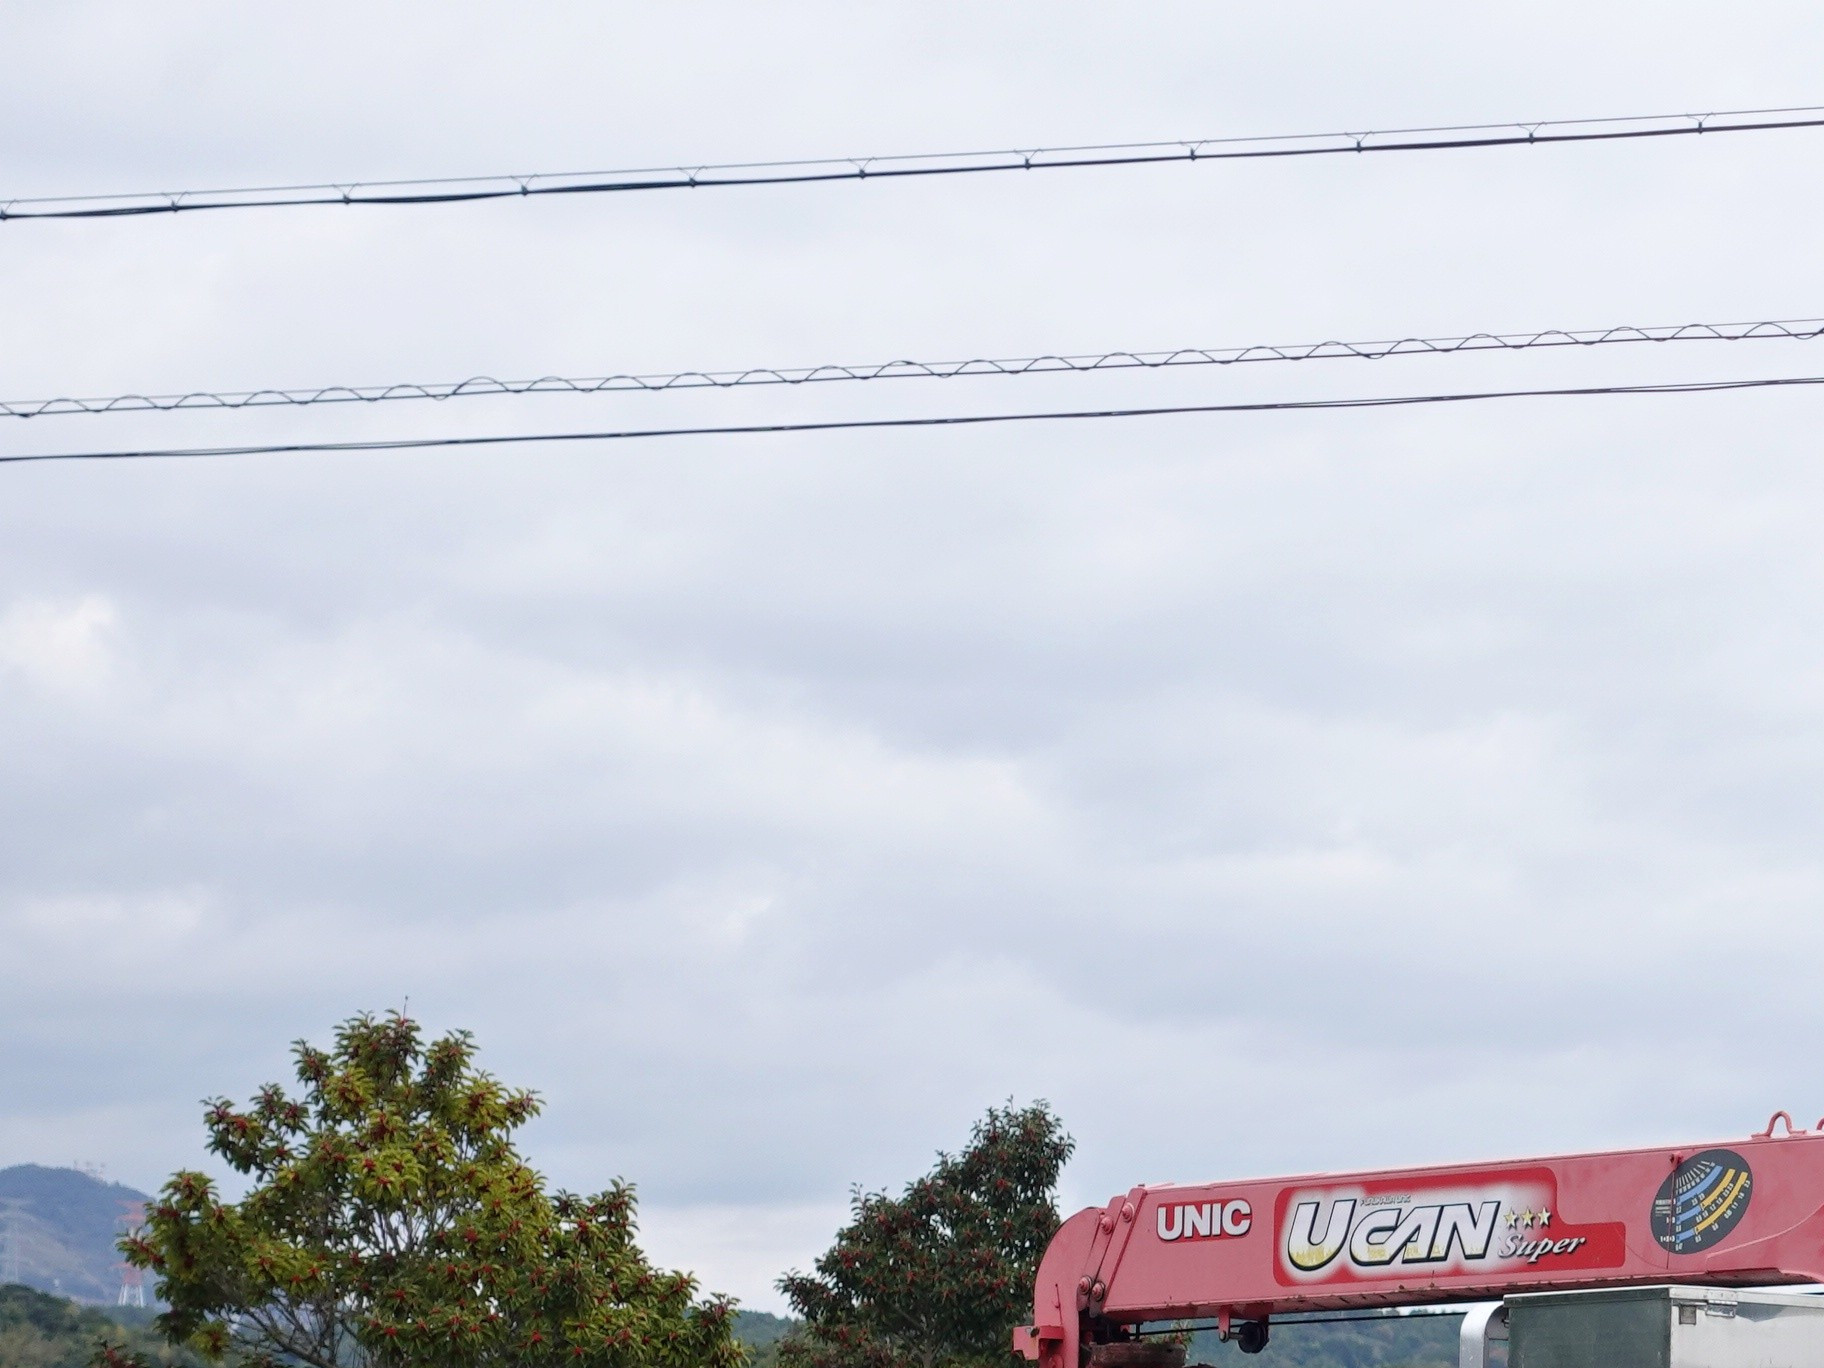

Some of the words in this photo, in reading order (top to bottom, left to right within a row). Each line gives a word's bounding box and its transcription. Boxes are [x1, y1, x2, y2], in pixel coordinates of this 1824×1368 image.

[1156, 1199, 1252, 1241] UNIC
[1288, 1198, 1501, 1271] UCAN
[1498, 1232, 1587, 1264] Super
